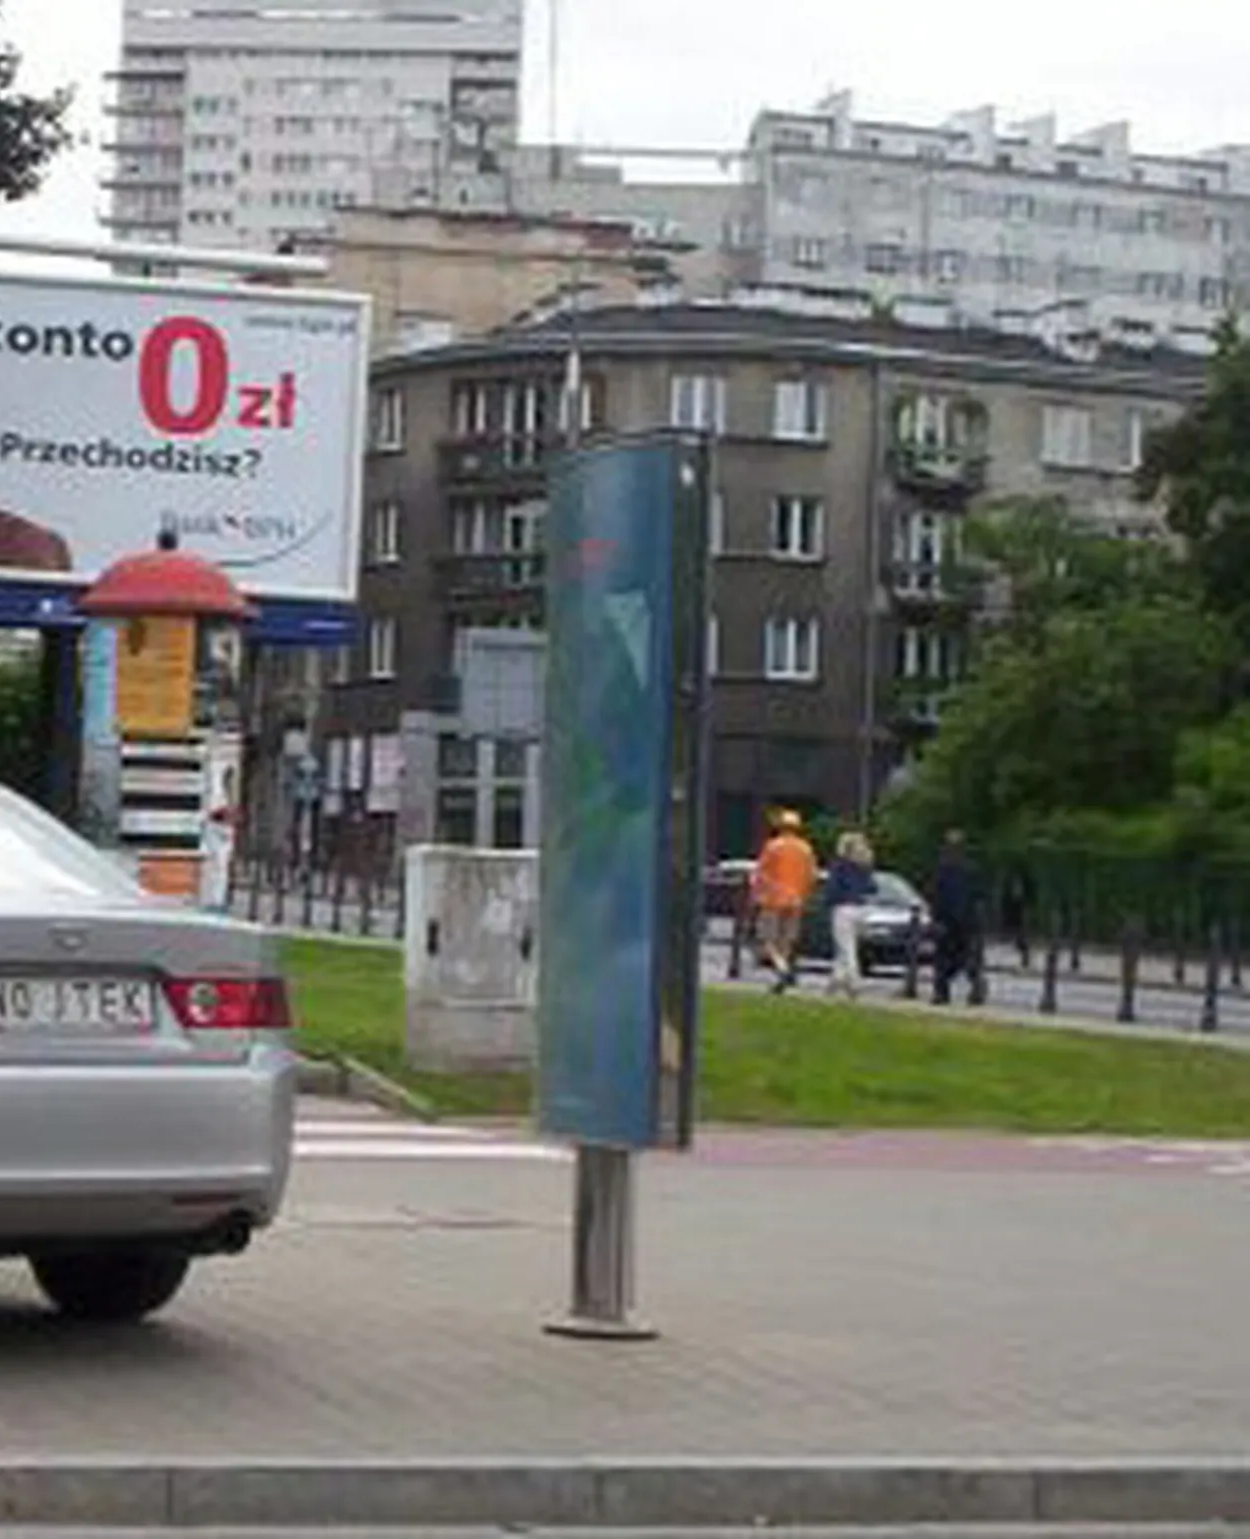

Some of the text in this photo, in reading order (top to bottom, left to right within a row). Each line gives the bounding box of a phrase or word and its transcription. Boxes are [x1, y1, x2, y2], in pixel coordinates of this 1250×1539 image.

[138, 316, 228, 434] 0
[237, 372, 296, 429] zł
[0, 432, 263, 478] Przechodzisz?
